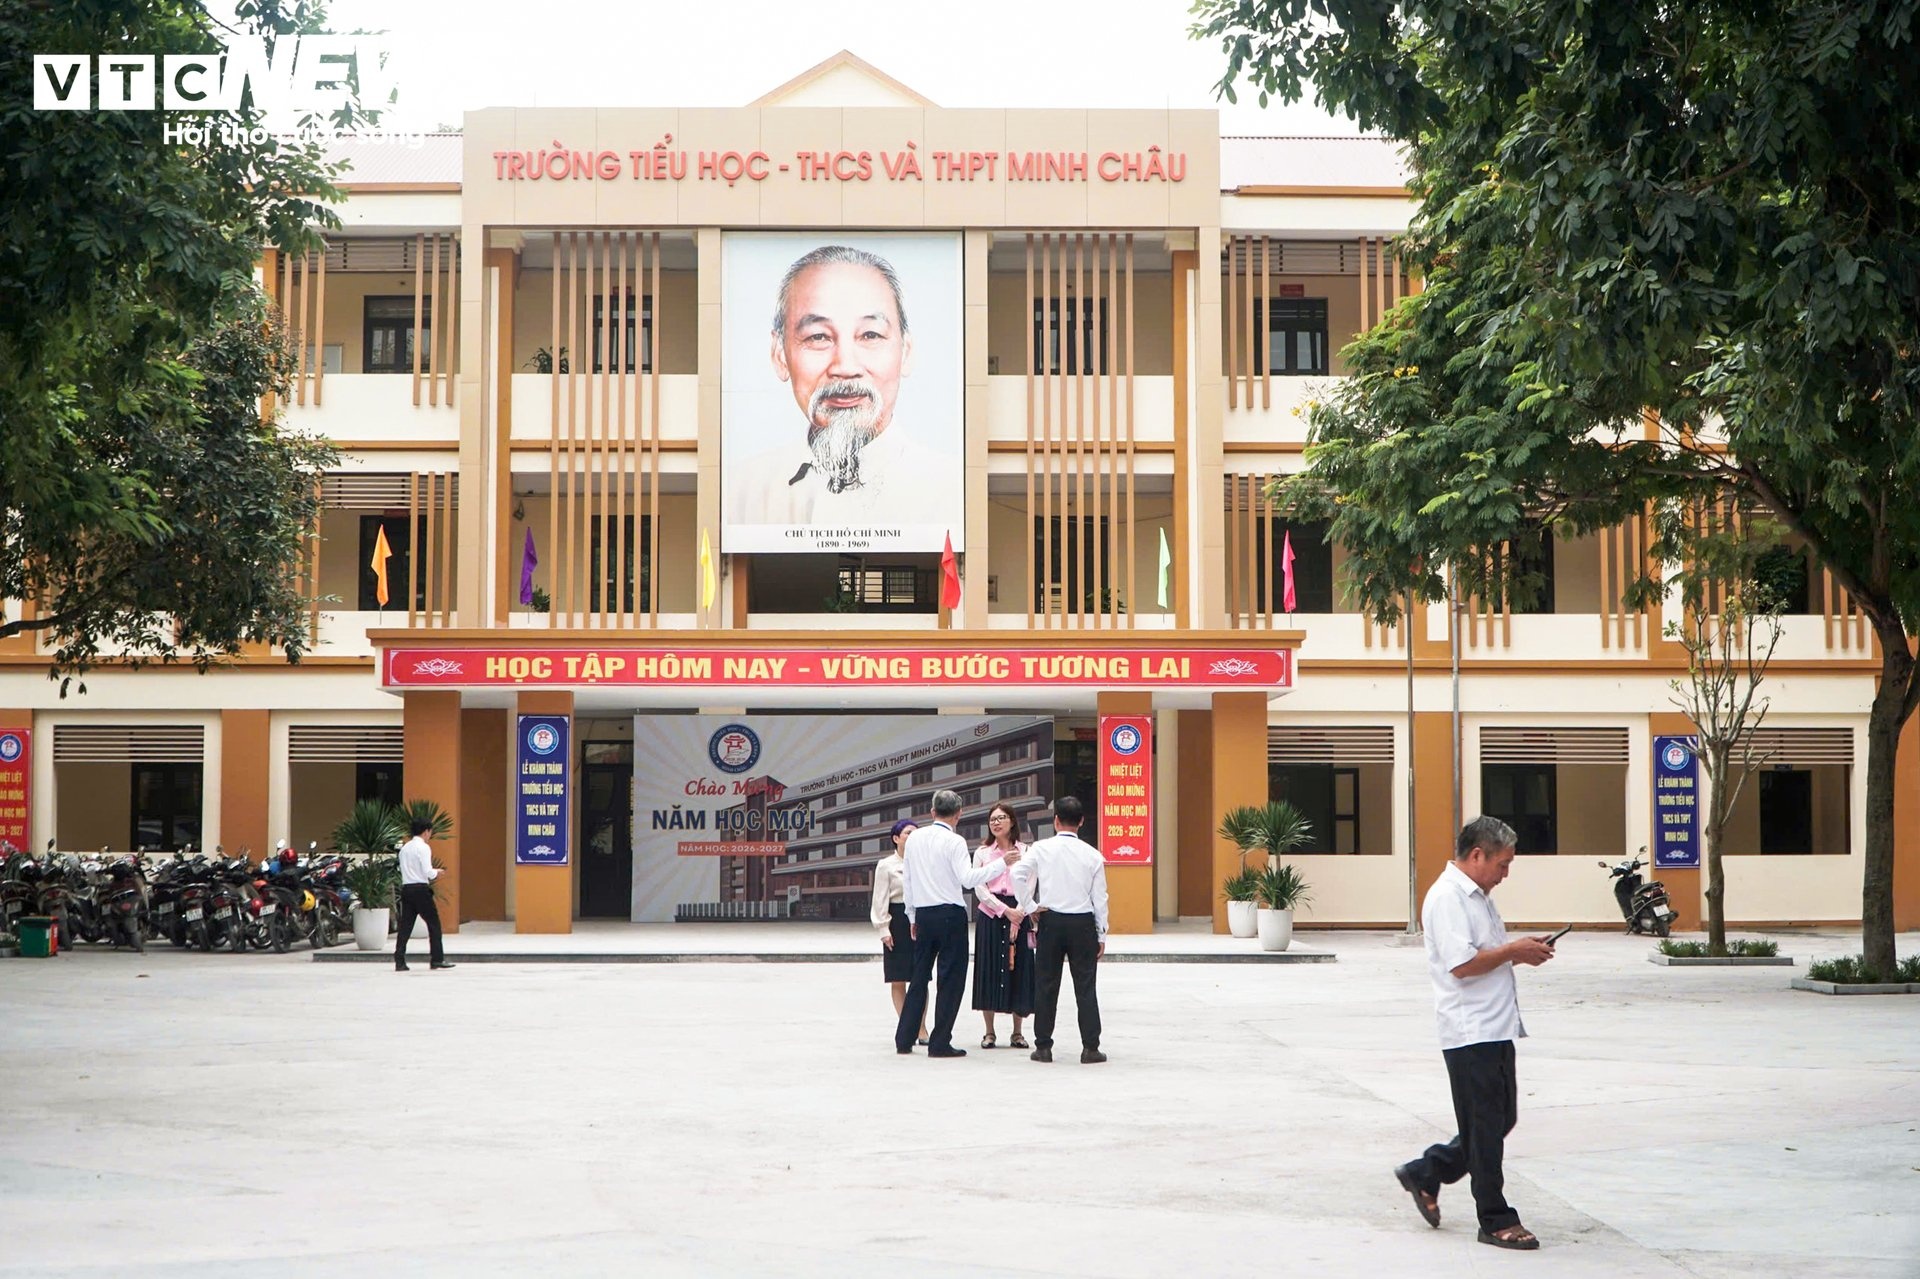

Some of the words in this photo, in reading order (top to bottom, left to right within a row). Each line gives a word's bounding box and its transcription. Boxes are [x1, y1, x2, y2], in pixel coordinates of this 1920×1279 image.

[493, 139, 622, 181] TRƯỜNG
[630, 133, 687, 181] TIỂU
[698, 151, 770, 187] HỌC
[797, 152, 872, 181] THCS
[880, 140, 923, 181] VÀ
[932, 152, 999, 182] THPT
[1008, 152, 1088, 182] MINH
[1098, 145, 1187, 182] CHÂU
[809, 529, 834, 540] TỊCH
[874, 529, 901, 538] MINH
[486, 656, 552, 683] HỌC
[563, 652, 626, 683] TẬP
[637, 653, 712, 679] HÔM
[724, 657, 788, 679] NAY
[820, 654, 910, 679] VỮNG
[922, 653, 1010, 679] BƯỚC
[1020, 656, 1130, 679] TƯƠNG
[1141, 657, 1190, 678] LAI
[840, 771, 854, 782] HỌC
[858, 764, 877, 776] THCS
[878, 758, 888, 770] VÀ
[890, 754, 910, 766] THPT
[910, 746, 930, 760] MINH
[932, 737, 957, 752] CHÂU
[1110, 763, 1128, 779] NHIỆT
[1130, 763, 1142, 779] LIỆT
[685, 777, 726, 795] Chào
[1108, 783, 1124, 796] CHÀO
[1126, 782, 1144, 796] MỪNG
[526, 804, 539, 816] THCS
[547, 804, 559, 816] THPT
[1105, 803, 1120, 816] NĂM
[1121, 806, 1134, 818] HỌC
[1135, 802, 1147, 816] MỚI
[652, 804, 706, 830] NĂM
[715, 809, 761, 835] HỌC
[769, 802, 816, 830] MỚI
[1129, 826, 1144, 836] 2027
[680, 844, 703, 852] NĂM
